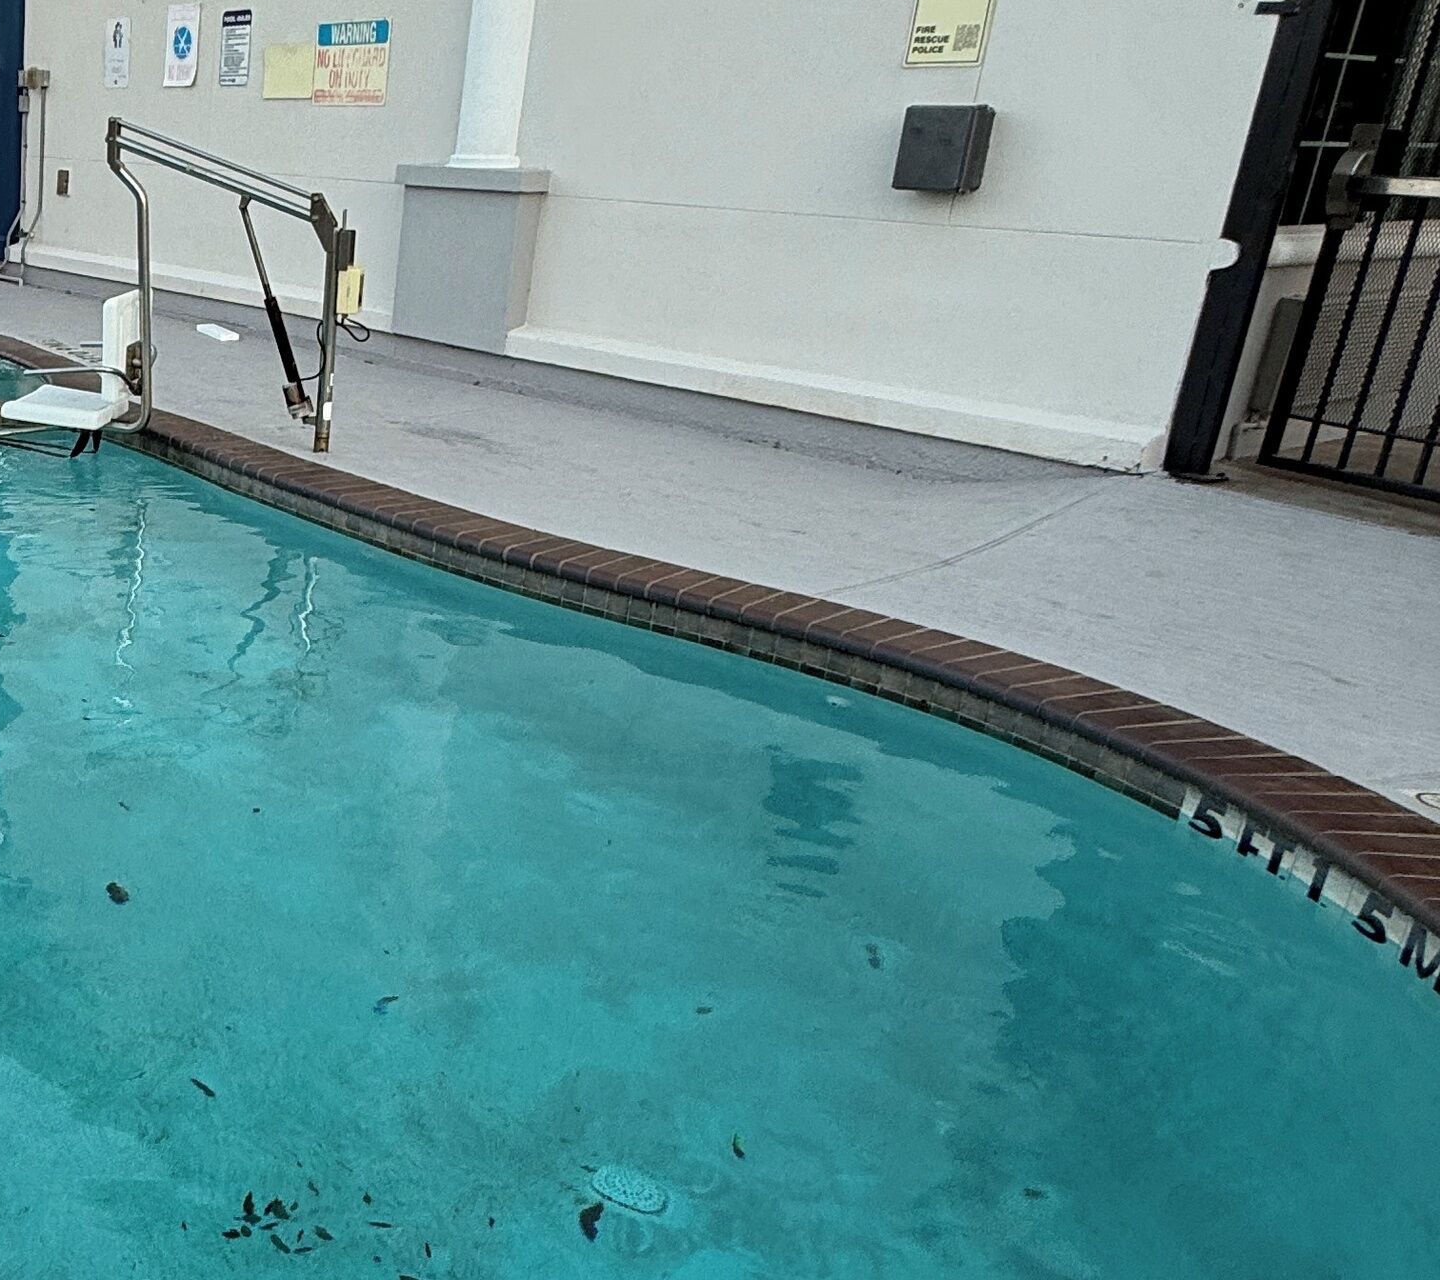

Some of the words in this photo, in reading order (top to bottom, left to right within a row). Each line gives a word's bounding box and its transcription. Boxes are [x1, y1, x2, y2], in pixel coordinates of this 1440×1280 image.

[331, 22, 377, 44] WARNING
[915, 25, 937, 34] FIRE
[913, 35, 950, 44] RESCUE
[911, 45, 944, 54] POLICE
[317, 48, 330, 69] NO
[328, 70, 342, 89] ON
